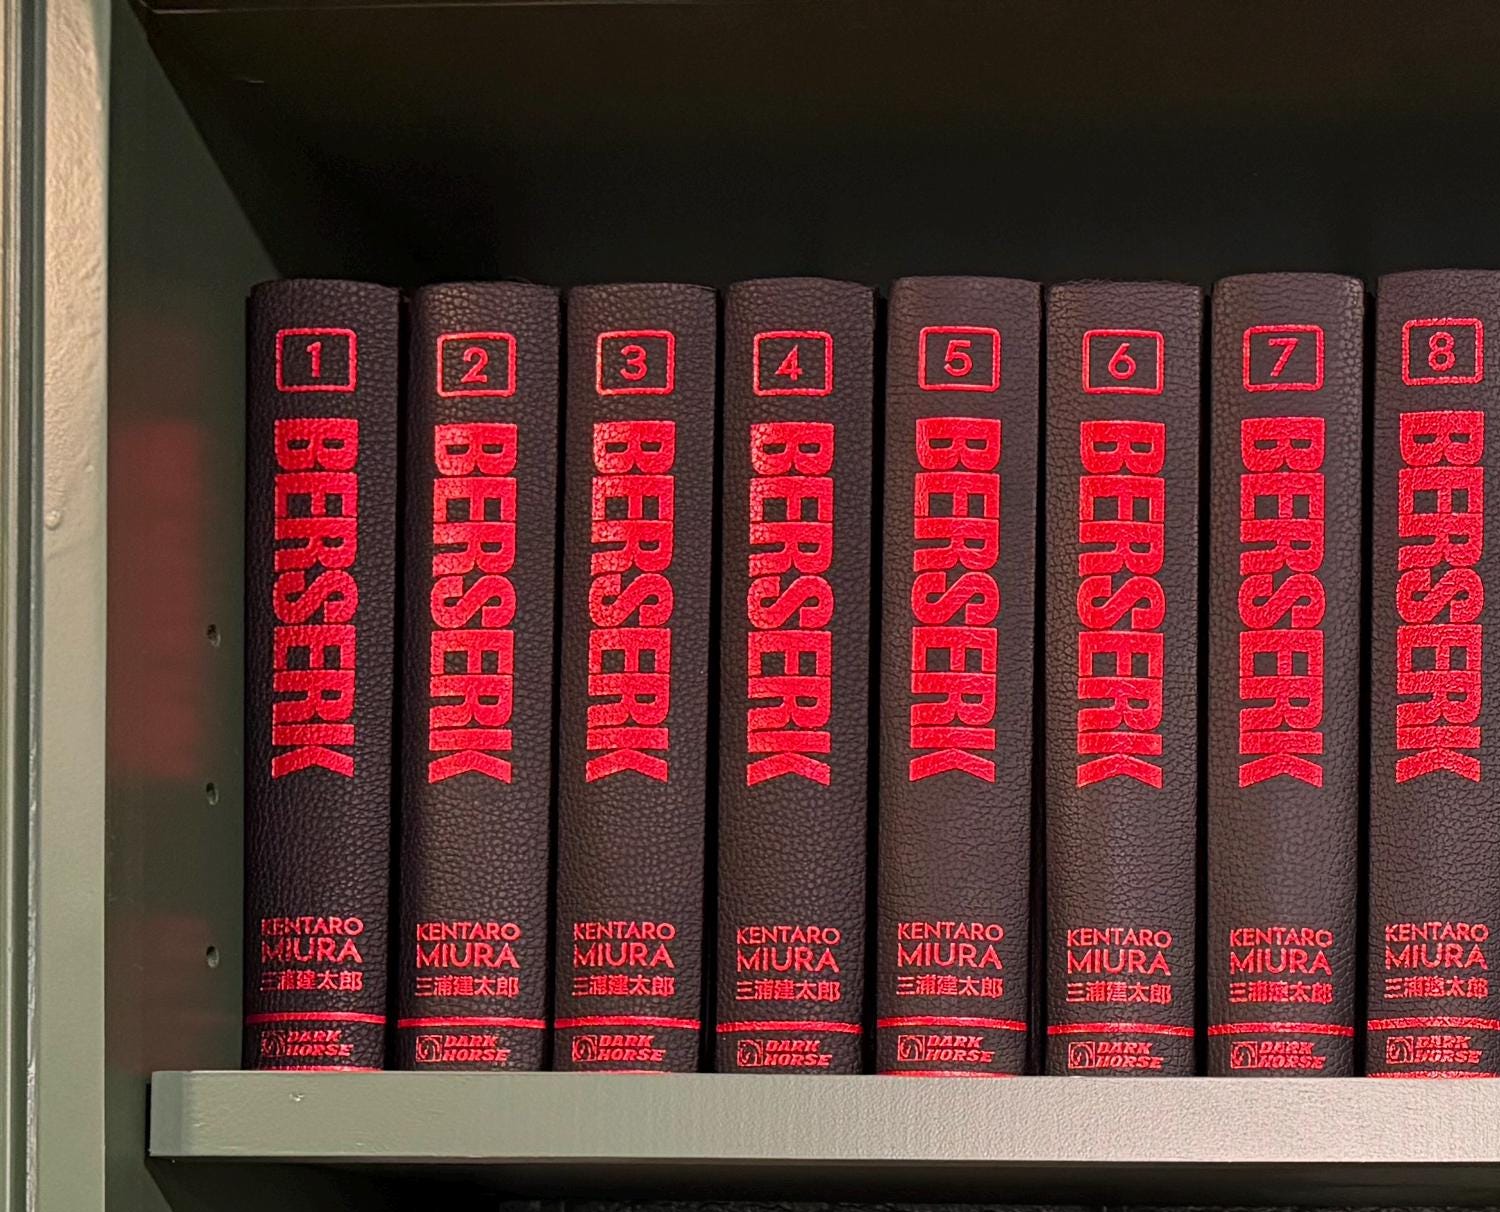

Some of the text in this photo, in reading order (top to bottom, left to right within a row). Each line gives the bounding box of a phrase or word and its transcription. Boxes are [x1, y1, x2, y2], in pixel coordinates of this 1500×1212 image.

[305, 339, 324, 378] 1
[460, 346, 491, 383] 2
[619, 344, 648, 380] 3
[774, 345, 805, 380] 4
[943, 339, 973, 375] 5
[1108, 340, 1138, 378] 6
[1267, 337, 1298, 378] 7
[1427, 332, 1455, 370] 8
[271, 417, 360, 780] BERSERK
[427, 420, 520, 784] BERSERK
[584, 418, 677, 784] BERSERK
[745, 419, 836, 788] BERSERK
[907, 415, 1003, 784] BERSERK
[1075, 418, 1167, 790] BERSERK
[1237, 415, 1327, 790] BERSERK
[1394, 409, 1486, 784] BERSERK
[262, 916, 365, 938] KENTARO
[416, 920, 522, 942] KENTARO
[573, 920, 677, 942] KENTARO
[736, 924, 842, 946] KENTARO
[897, 920, 1005, 942] KENTARO
[1067, 927, 1173, 948] KENTARO
[1229, 925, 1334, 948] KENTARO
[1385, 921, 1489, 944] KENTARO
[262, 938, 364, 964] MIURA
[416, 942, 520, 970] MIURA
[573, 942, 675, 970] MIURA
[736, 946, 841, 974] MIURA
[897, 942, 1004, 971] MIURA
[1067, 948, 1171, 976] MIURA
[1228, 948, 1333, 977] MIURA
[1385, 944, 1488, 971] MIURA
[443, 1048, 511, 1062] HORSE
[444, 1035, 497, 1048] DARK
[766, 1040, 820, 1053] DARK
[926, 1048, 995, 1063] HORSE
[928, 1035, 983, 1048] DARK
[764, 1052, 833, 1067] HORSE
